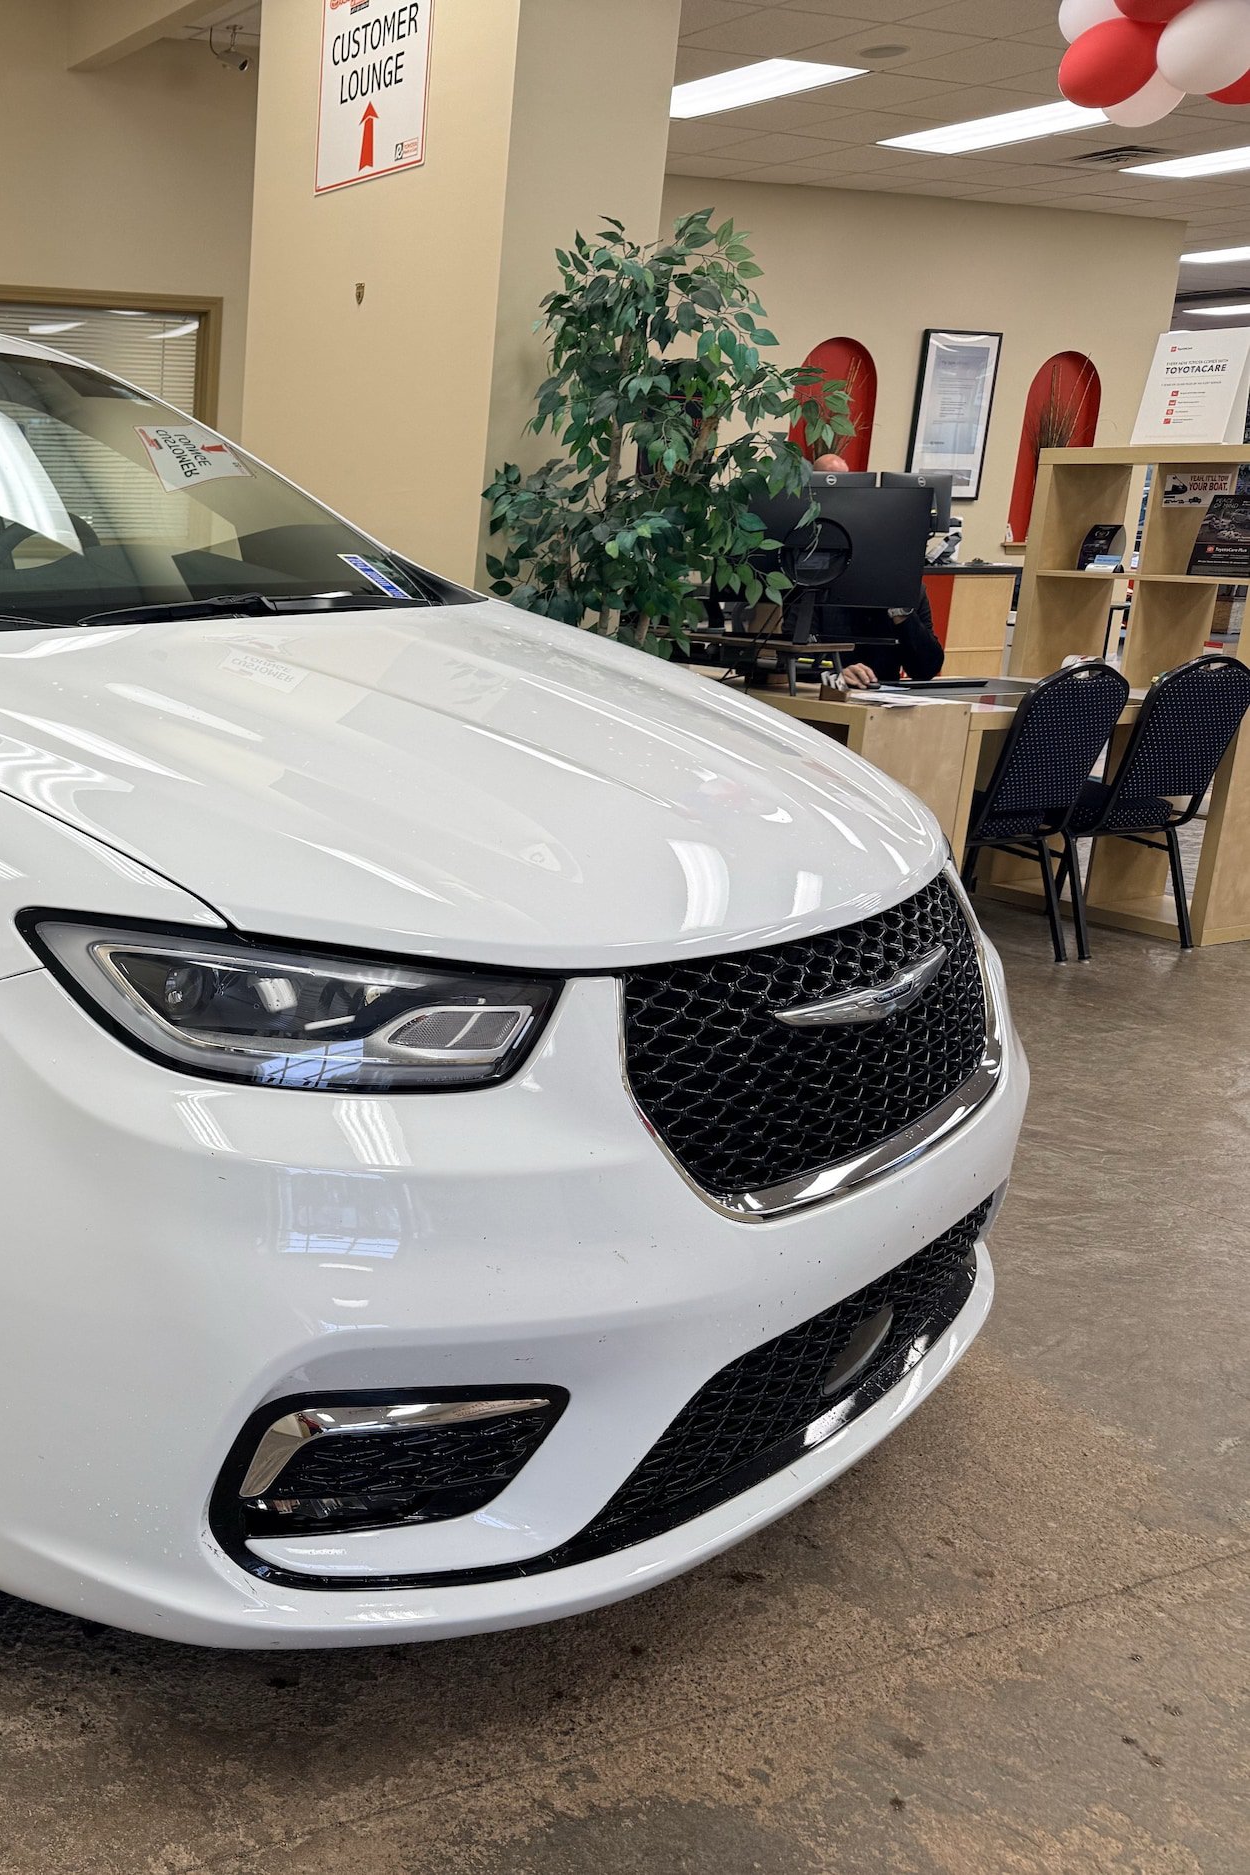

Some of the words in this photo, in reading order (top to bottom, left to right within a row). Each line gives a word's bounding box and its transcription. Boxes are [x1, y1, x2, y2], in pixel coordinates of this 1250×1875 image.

[332, 3, 419, 66] CUSTOMER
[340, 51, 405, 104] LOUNGE
[1165, 364, 1227, 374] TOYOTACARE
[1189, 482, 1208, 491] YOUR
[1209, 482, 1228, 491] BOAT.
